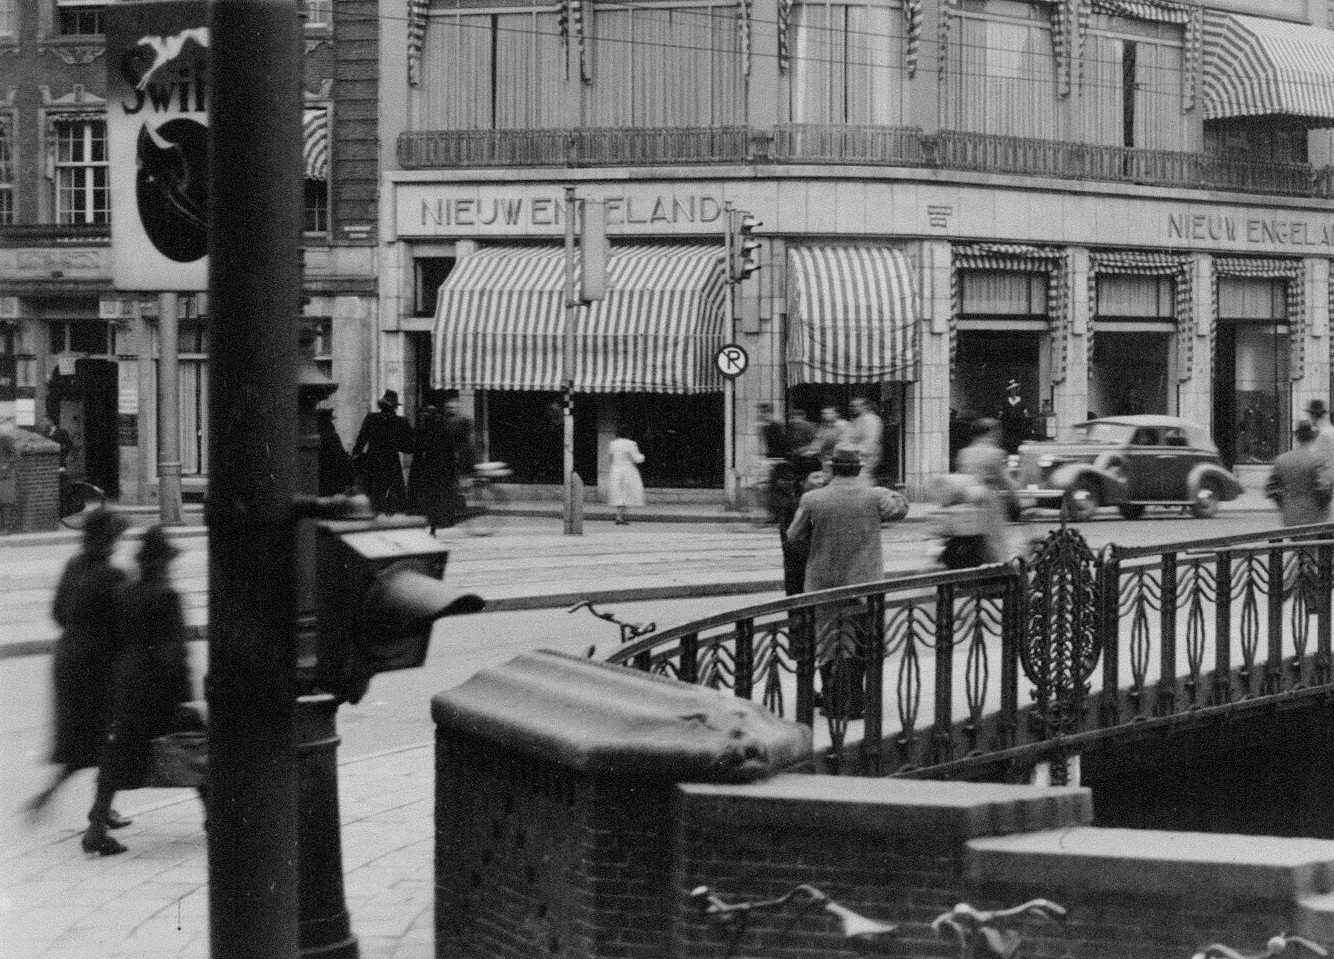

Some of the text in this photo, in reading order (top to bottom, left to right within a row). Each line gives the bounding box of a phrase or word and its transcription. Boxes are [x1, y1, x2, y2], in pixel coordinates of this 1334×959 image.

[420, 194, 722, 226] NIEUW ENELAND
[1168, 213, 1236, 241] NIEUW
